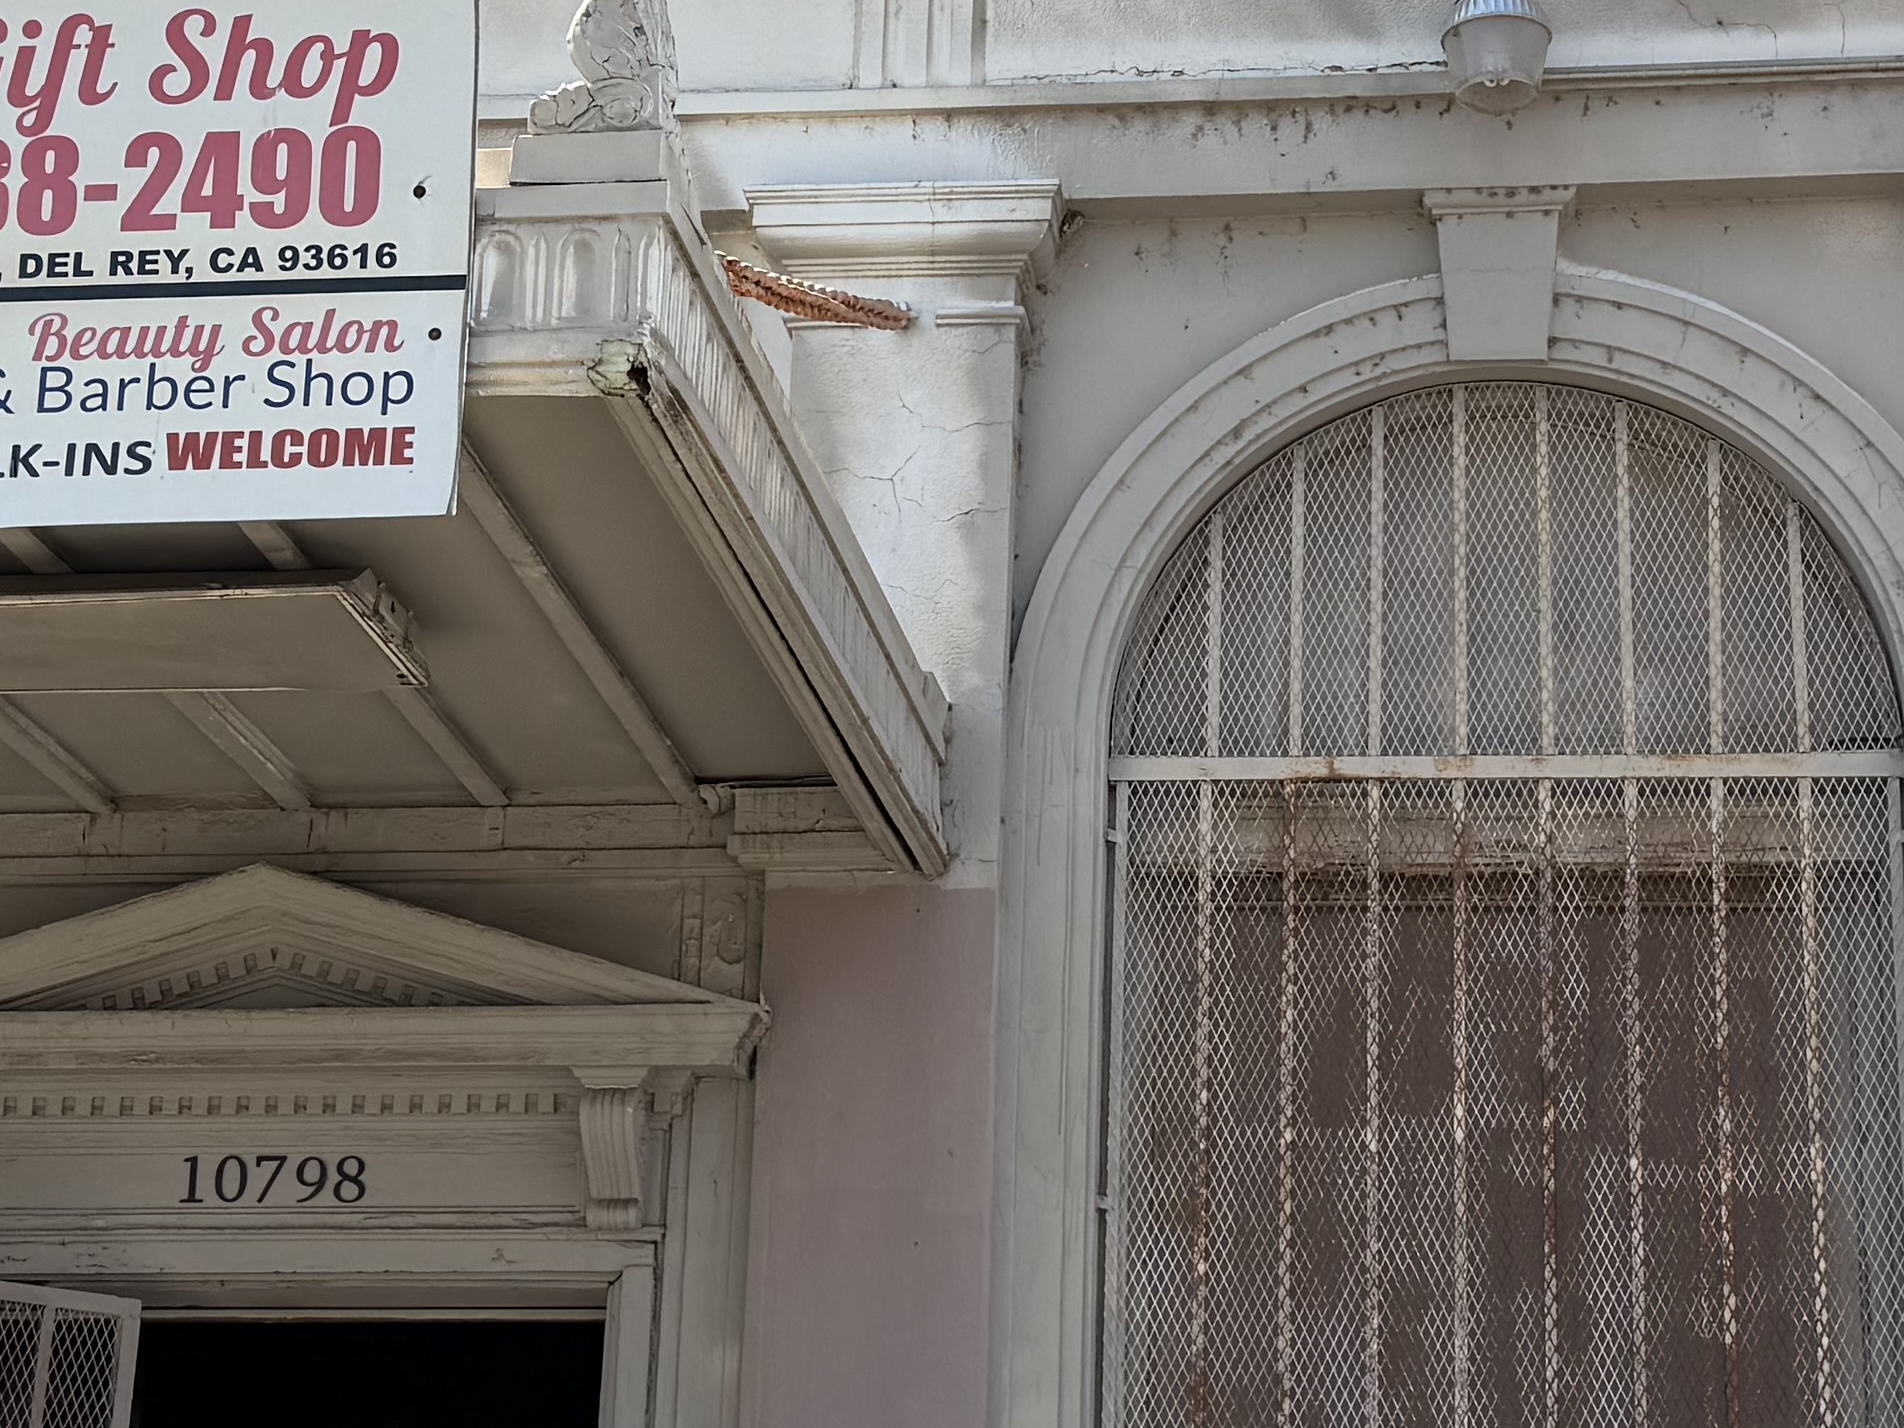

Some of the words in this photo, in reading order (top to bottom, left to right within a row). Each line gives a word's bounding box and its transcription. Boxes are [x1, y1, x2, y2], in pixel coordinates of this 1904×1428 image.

[147, 7, 399, 128] Shop
[18, 251, 95, 280] DEL
[108, 248, 192, 281] REY,
[209, 245, 265, 274] CA
[277, 241, 398, 271] 93616
[27, 312, 225, 374] Beauty
[240, 306, 404, 359] Salon
[36, 362, 246, 415] Barber
[263, 357, 416, 416] Shop
[165, 425, 416, 472] WELCOME
[177, 1154, 368, 1205] 10798
